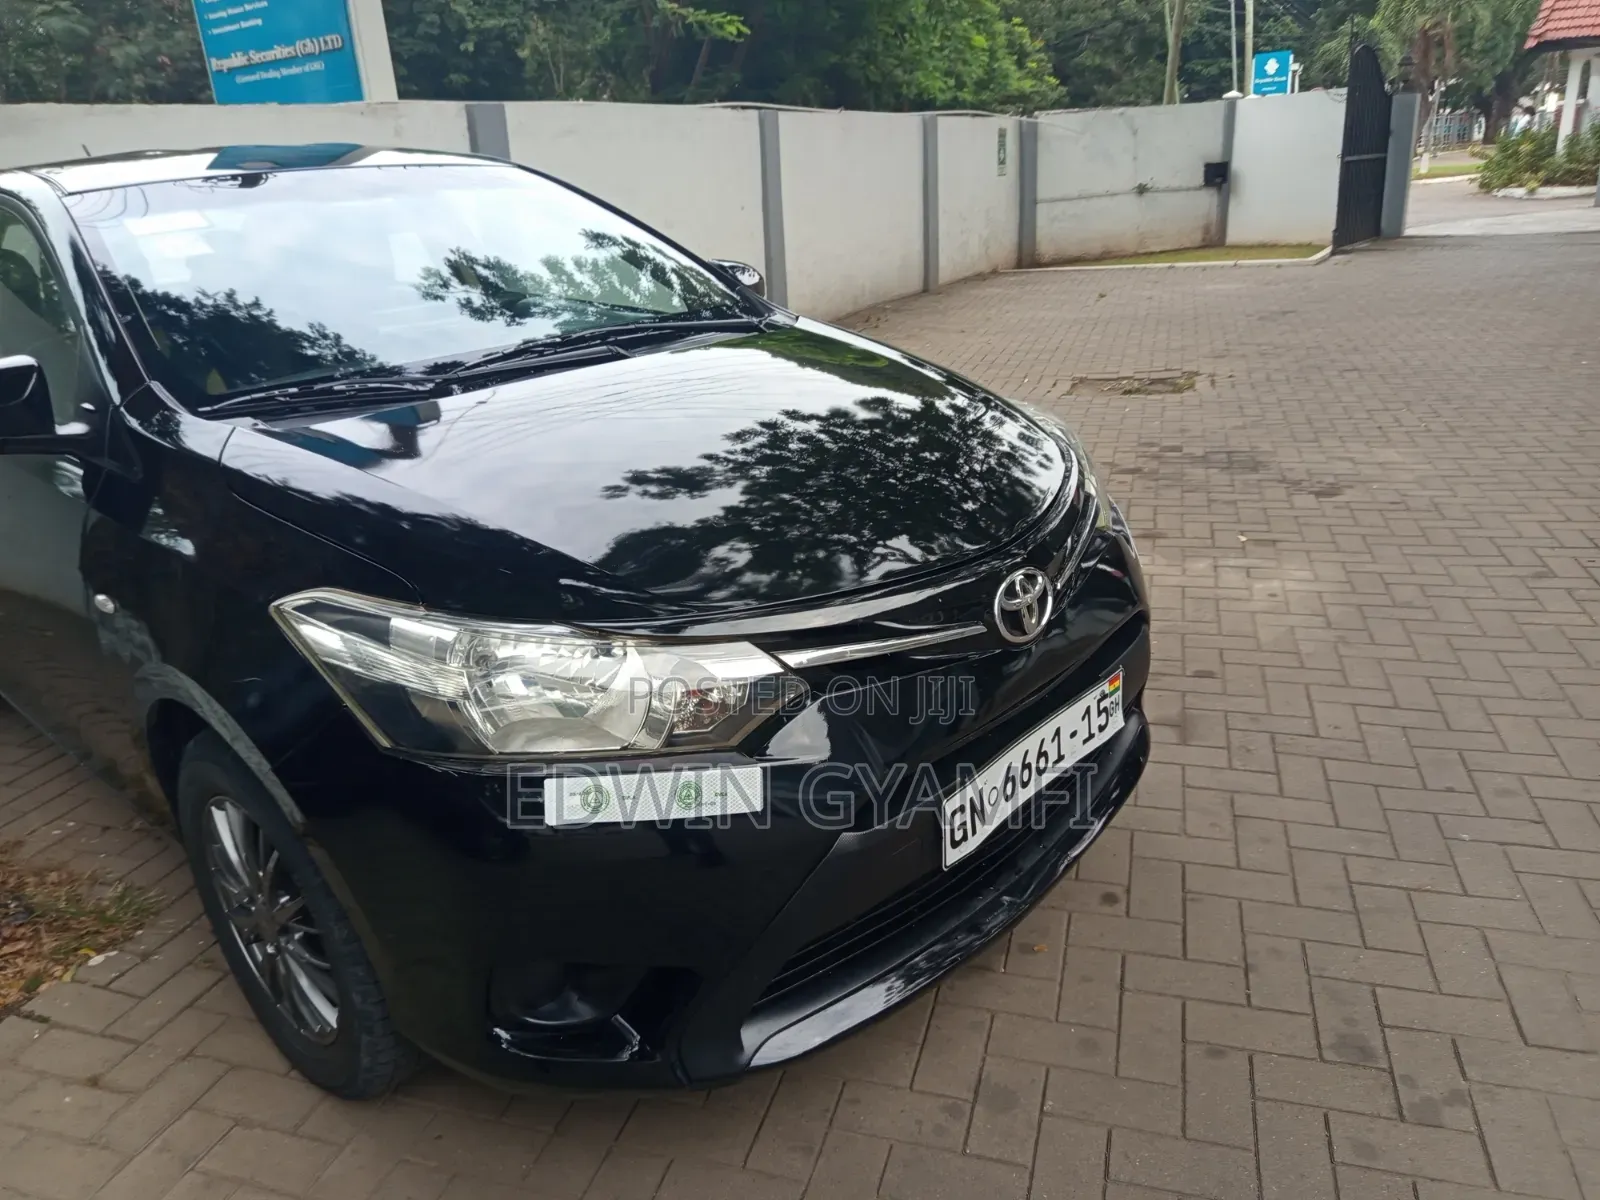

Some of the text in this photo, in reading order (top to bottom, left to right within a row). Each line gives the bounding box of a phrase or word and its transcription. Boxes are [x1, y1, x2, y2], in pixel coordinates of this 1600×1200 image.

[210, 34, 342, 72] Republic Securities (Gh) LTD
[1109, 694, 1120, 717] GH
[949, 692, 1110, 850] GN 6661-15
